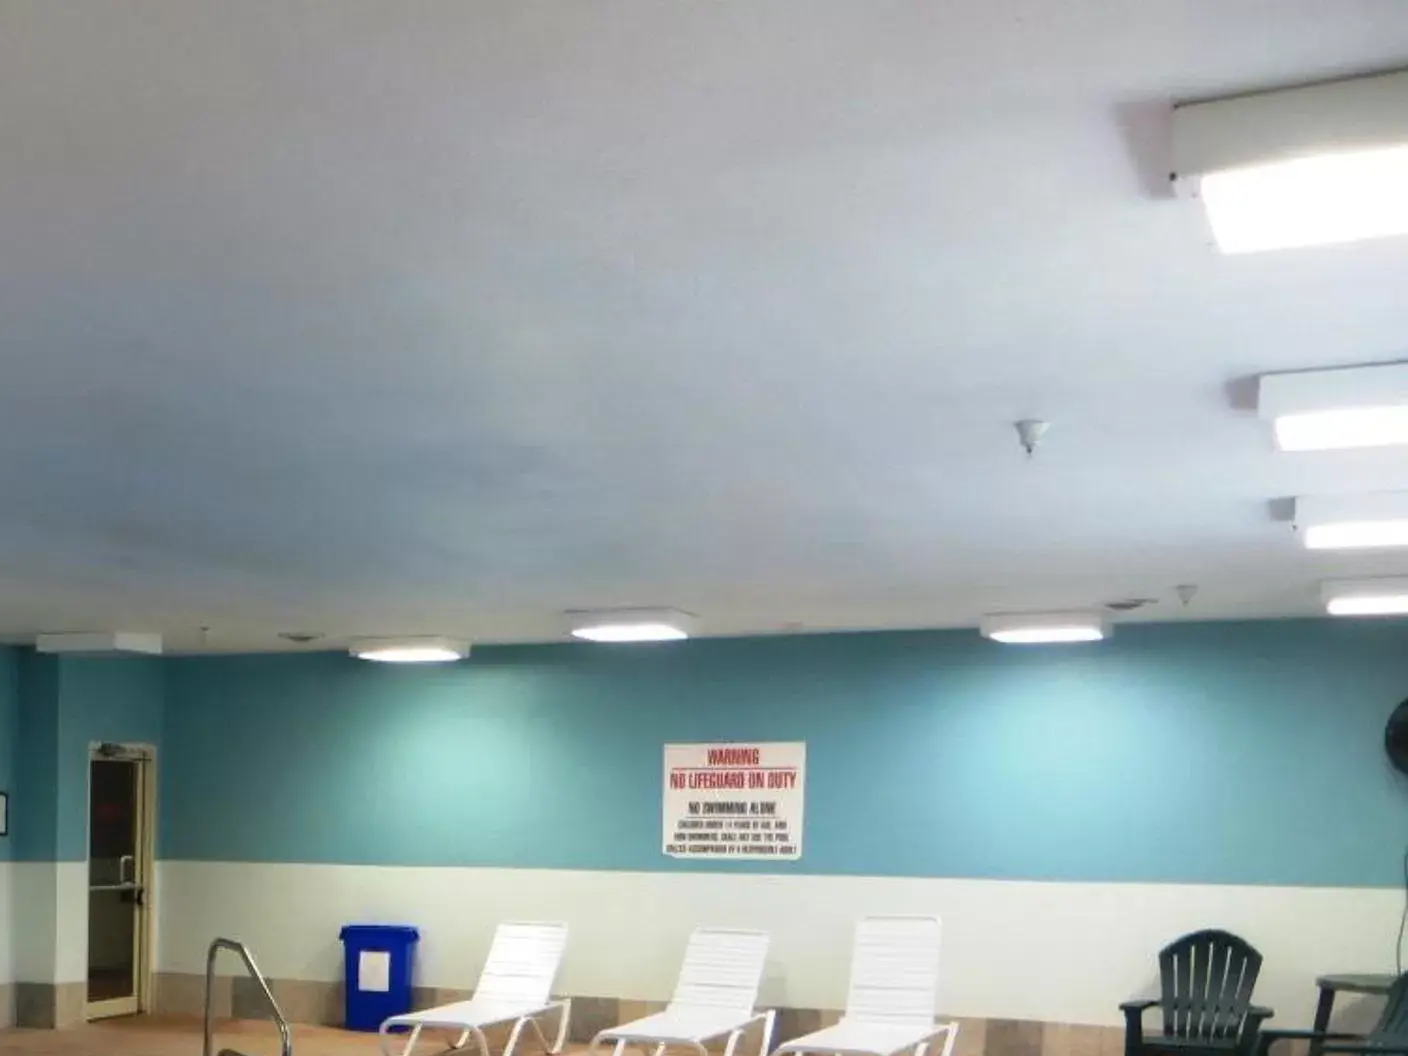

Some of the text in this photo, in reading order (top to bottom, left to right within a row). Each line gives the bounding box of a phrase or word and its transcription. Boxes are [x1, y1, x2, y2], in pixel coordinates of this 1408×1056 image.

[707, 748, 759, 765] WARNING
[670, 771, 796, 789] NO LIFEGUARD ON DUTY
